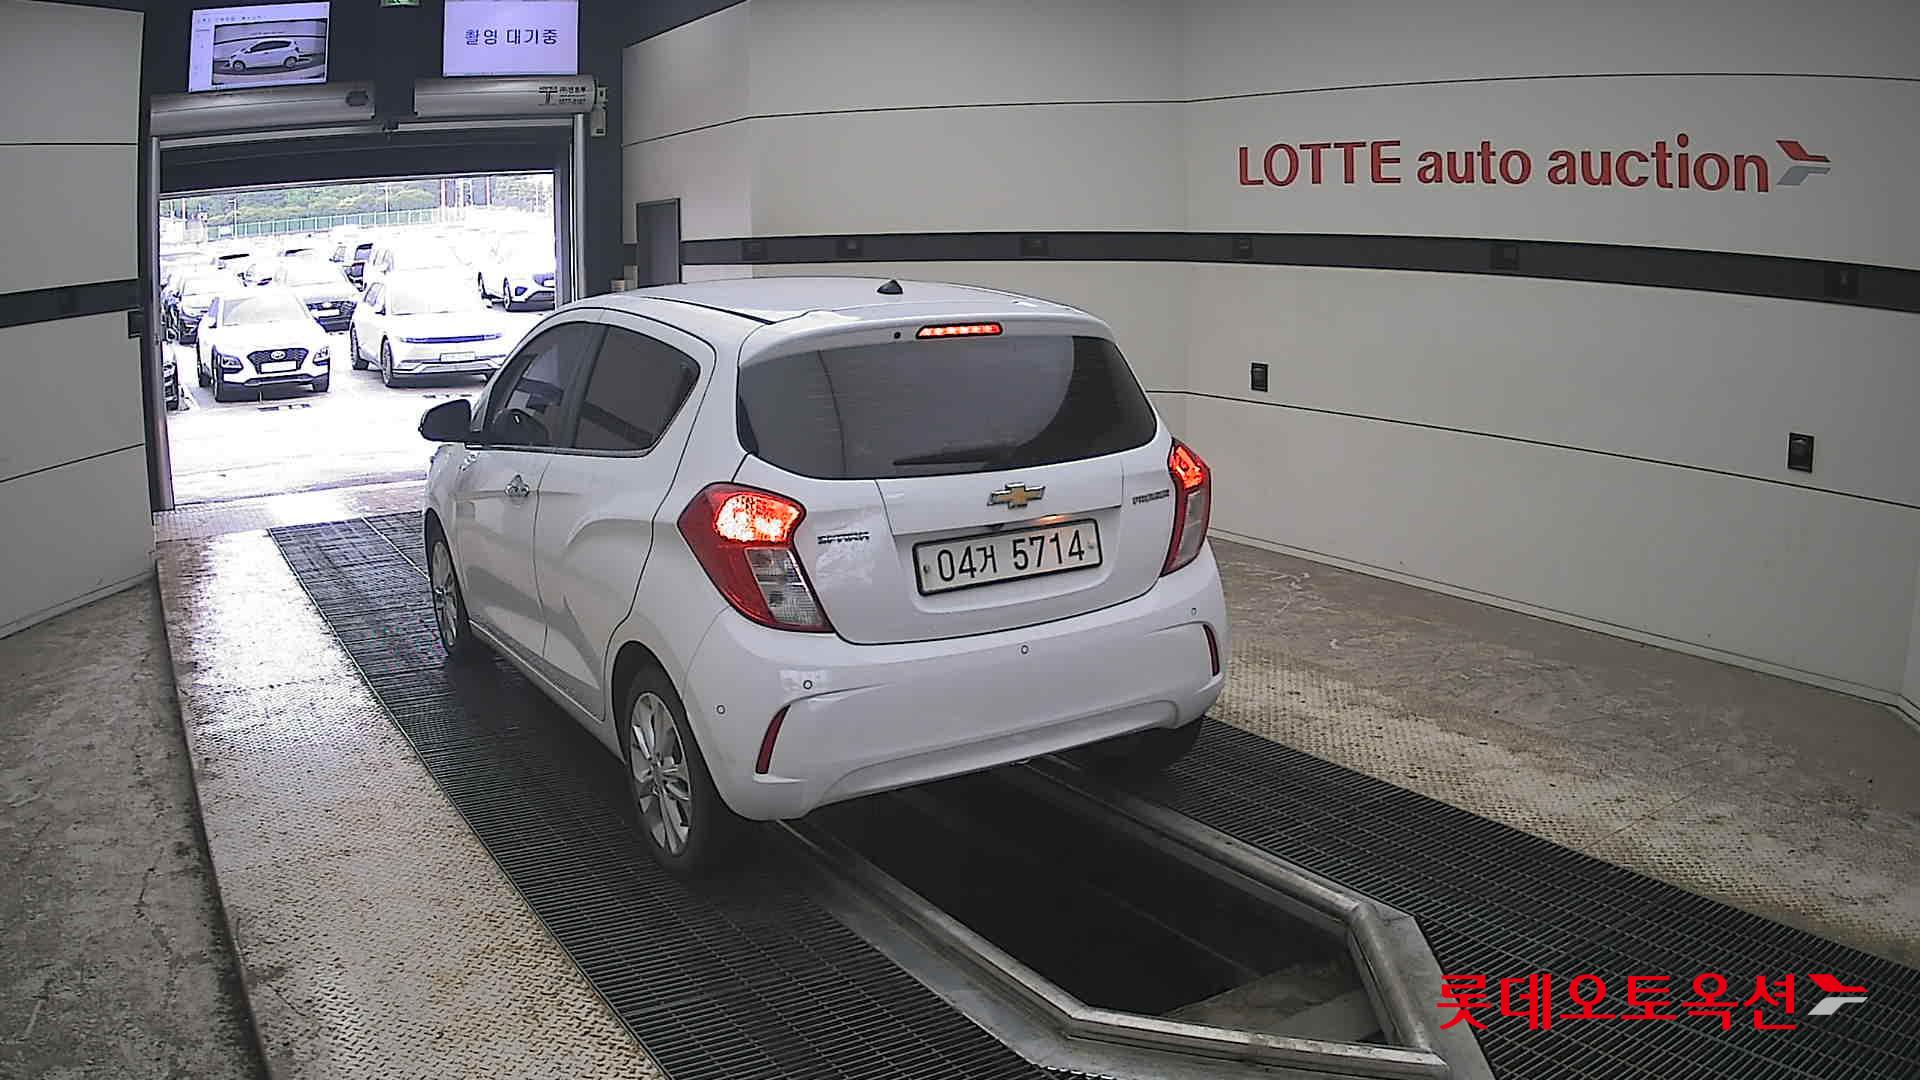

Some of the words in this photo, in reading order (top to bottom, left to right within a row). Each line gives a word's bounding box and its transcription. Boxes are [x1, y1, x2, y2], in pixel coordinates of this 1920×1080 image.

[506, 28, 558, 45] 대기중
[1239, 140, 1401, 186] LOTTE
[1417, 140, 1532, 186] auto
[1547, 132, 1770, 193] auction
[936, 544, 998, 582] 04거
[1011, 529, 1086, 571] 5714
